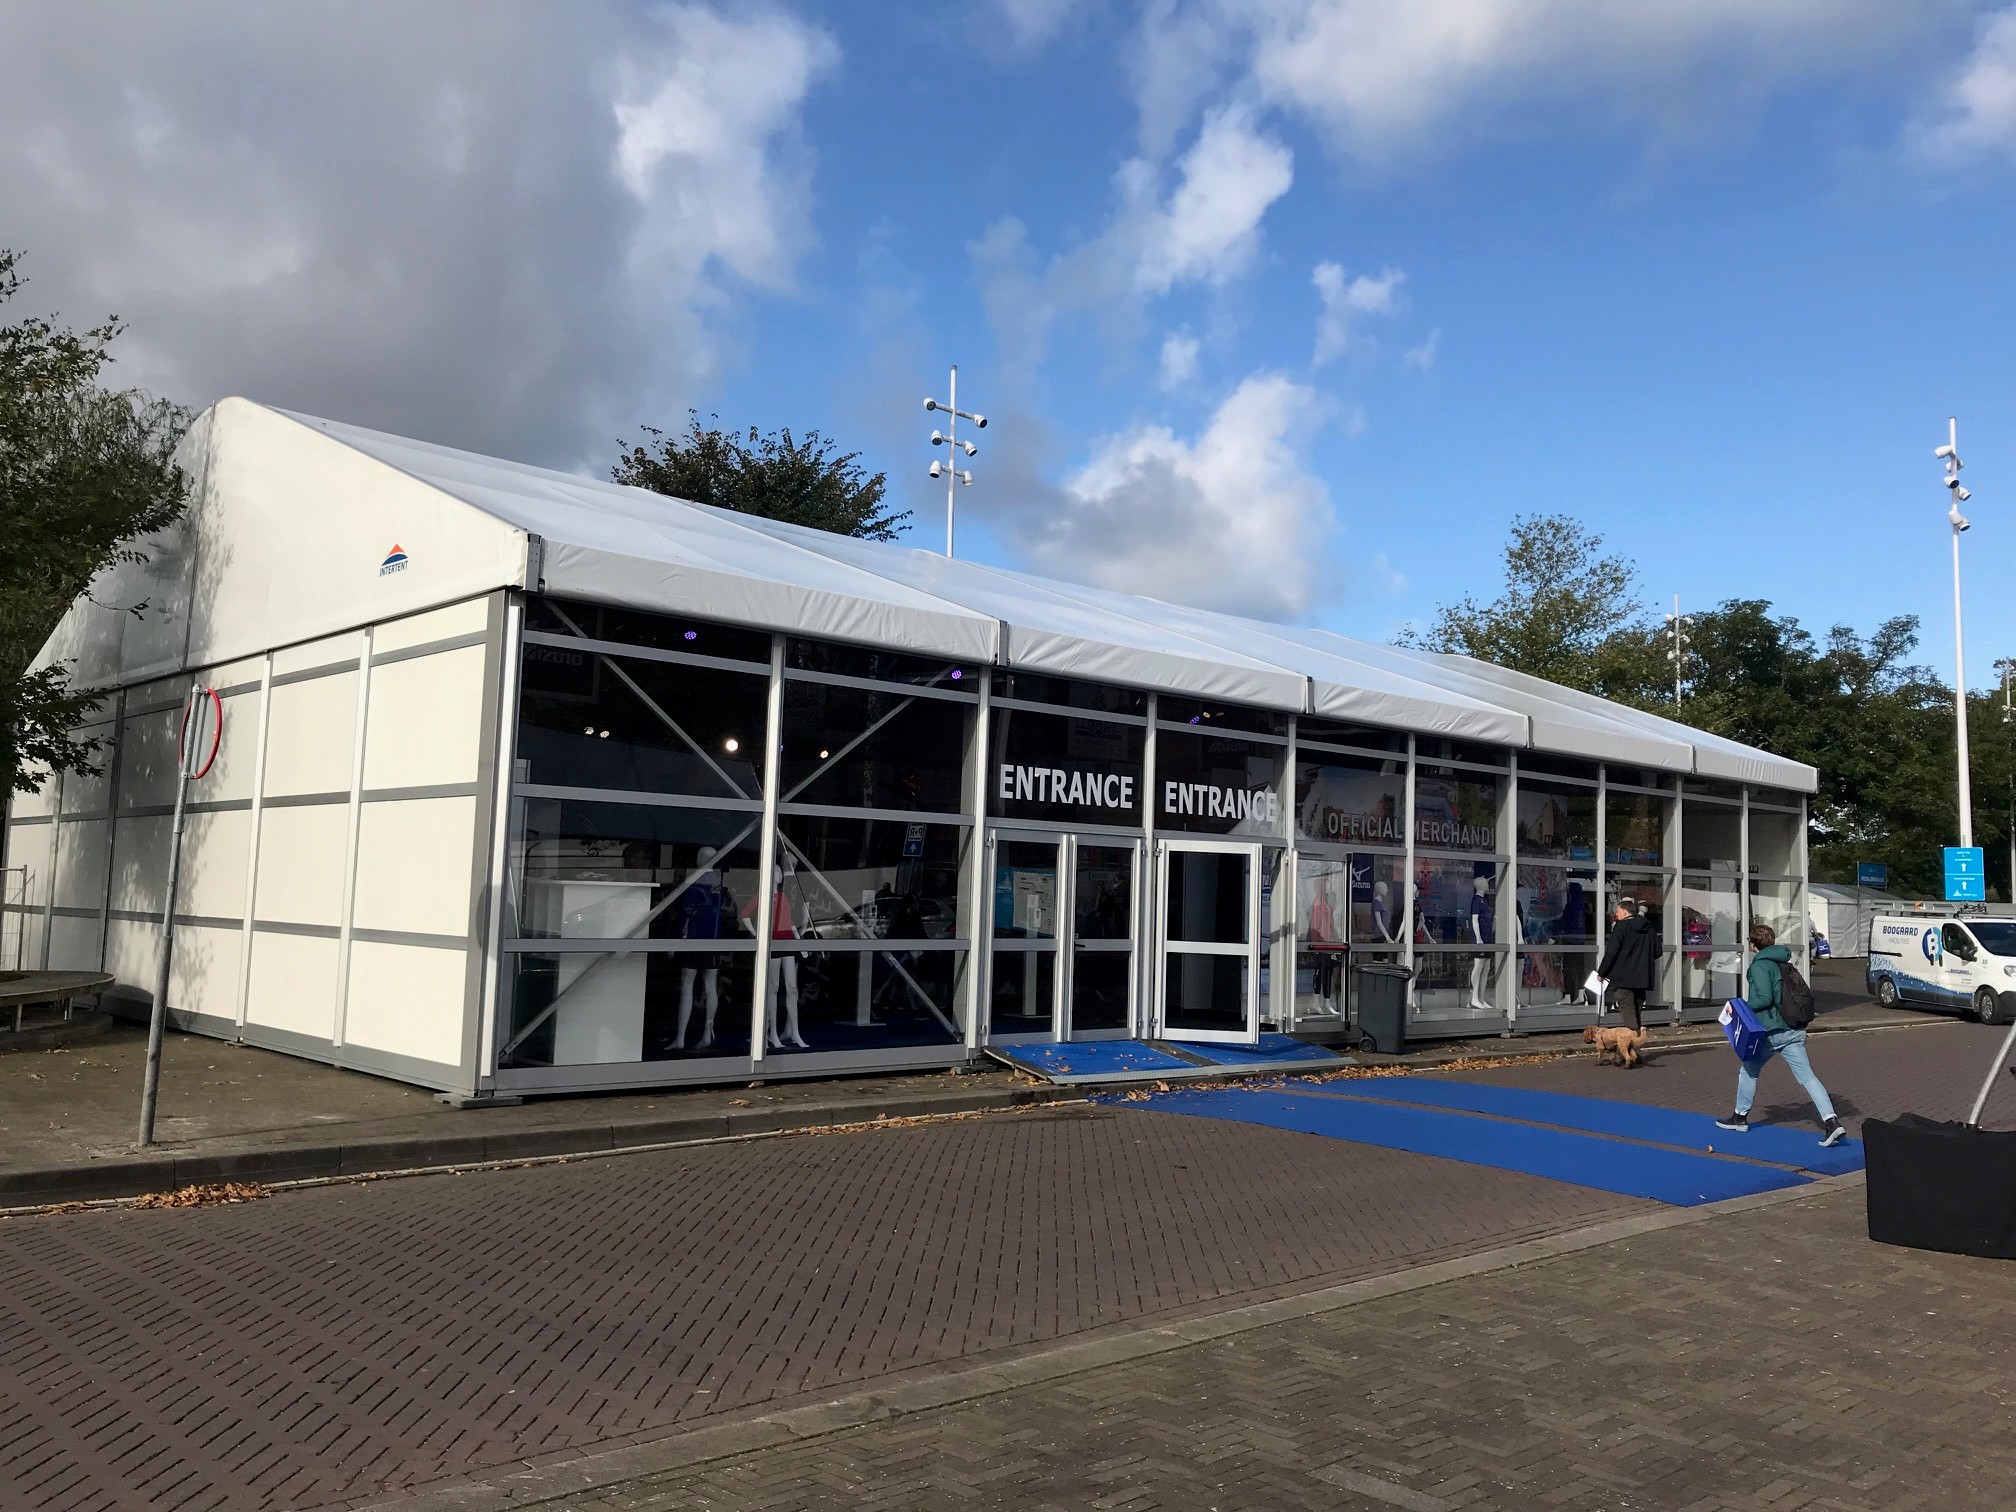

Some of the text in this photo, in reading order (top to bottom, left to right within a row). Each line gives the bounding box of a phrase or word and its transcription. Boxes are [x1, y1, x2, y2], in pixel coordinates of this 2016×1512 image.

[379, 560, 408, 577] INTERTENT
[1000, 764, 1133, 809] ENTRANCE
[1165, 781, 1277, 822] ENTRANCE
[1328, 812, 1403, 839] OFFICIAL
[1882, 925, 1919, 937] BOOGAARD
